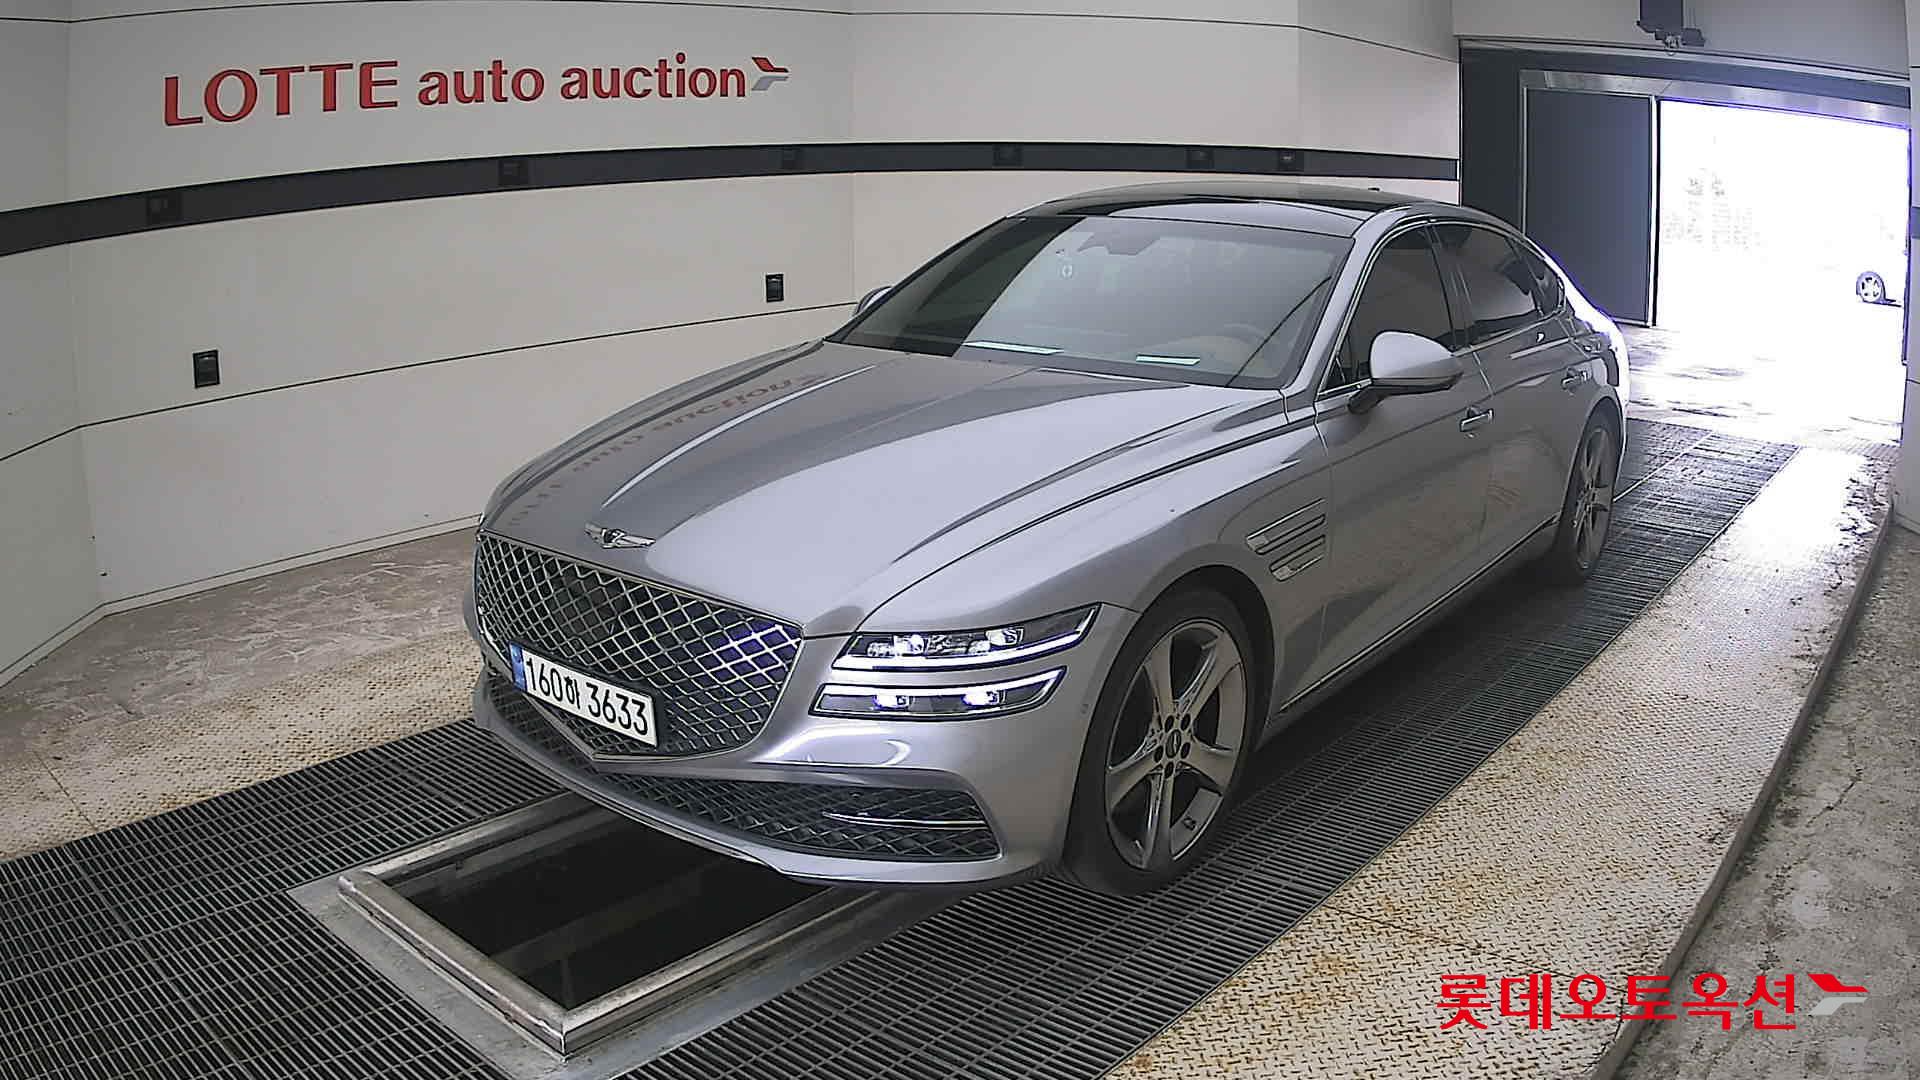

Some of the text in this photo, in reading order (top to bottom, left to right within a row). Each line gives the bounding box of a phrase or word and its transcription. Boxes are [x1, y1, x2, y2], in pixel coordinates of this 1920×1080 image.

[163, 52, 747, 126] LOTTE auto auction
[526, 657, 648, 736] 160하 3633
